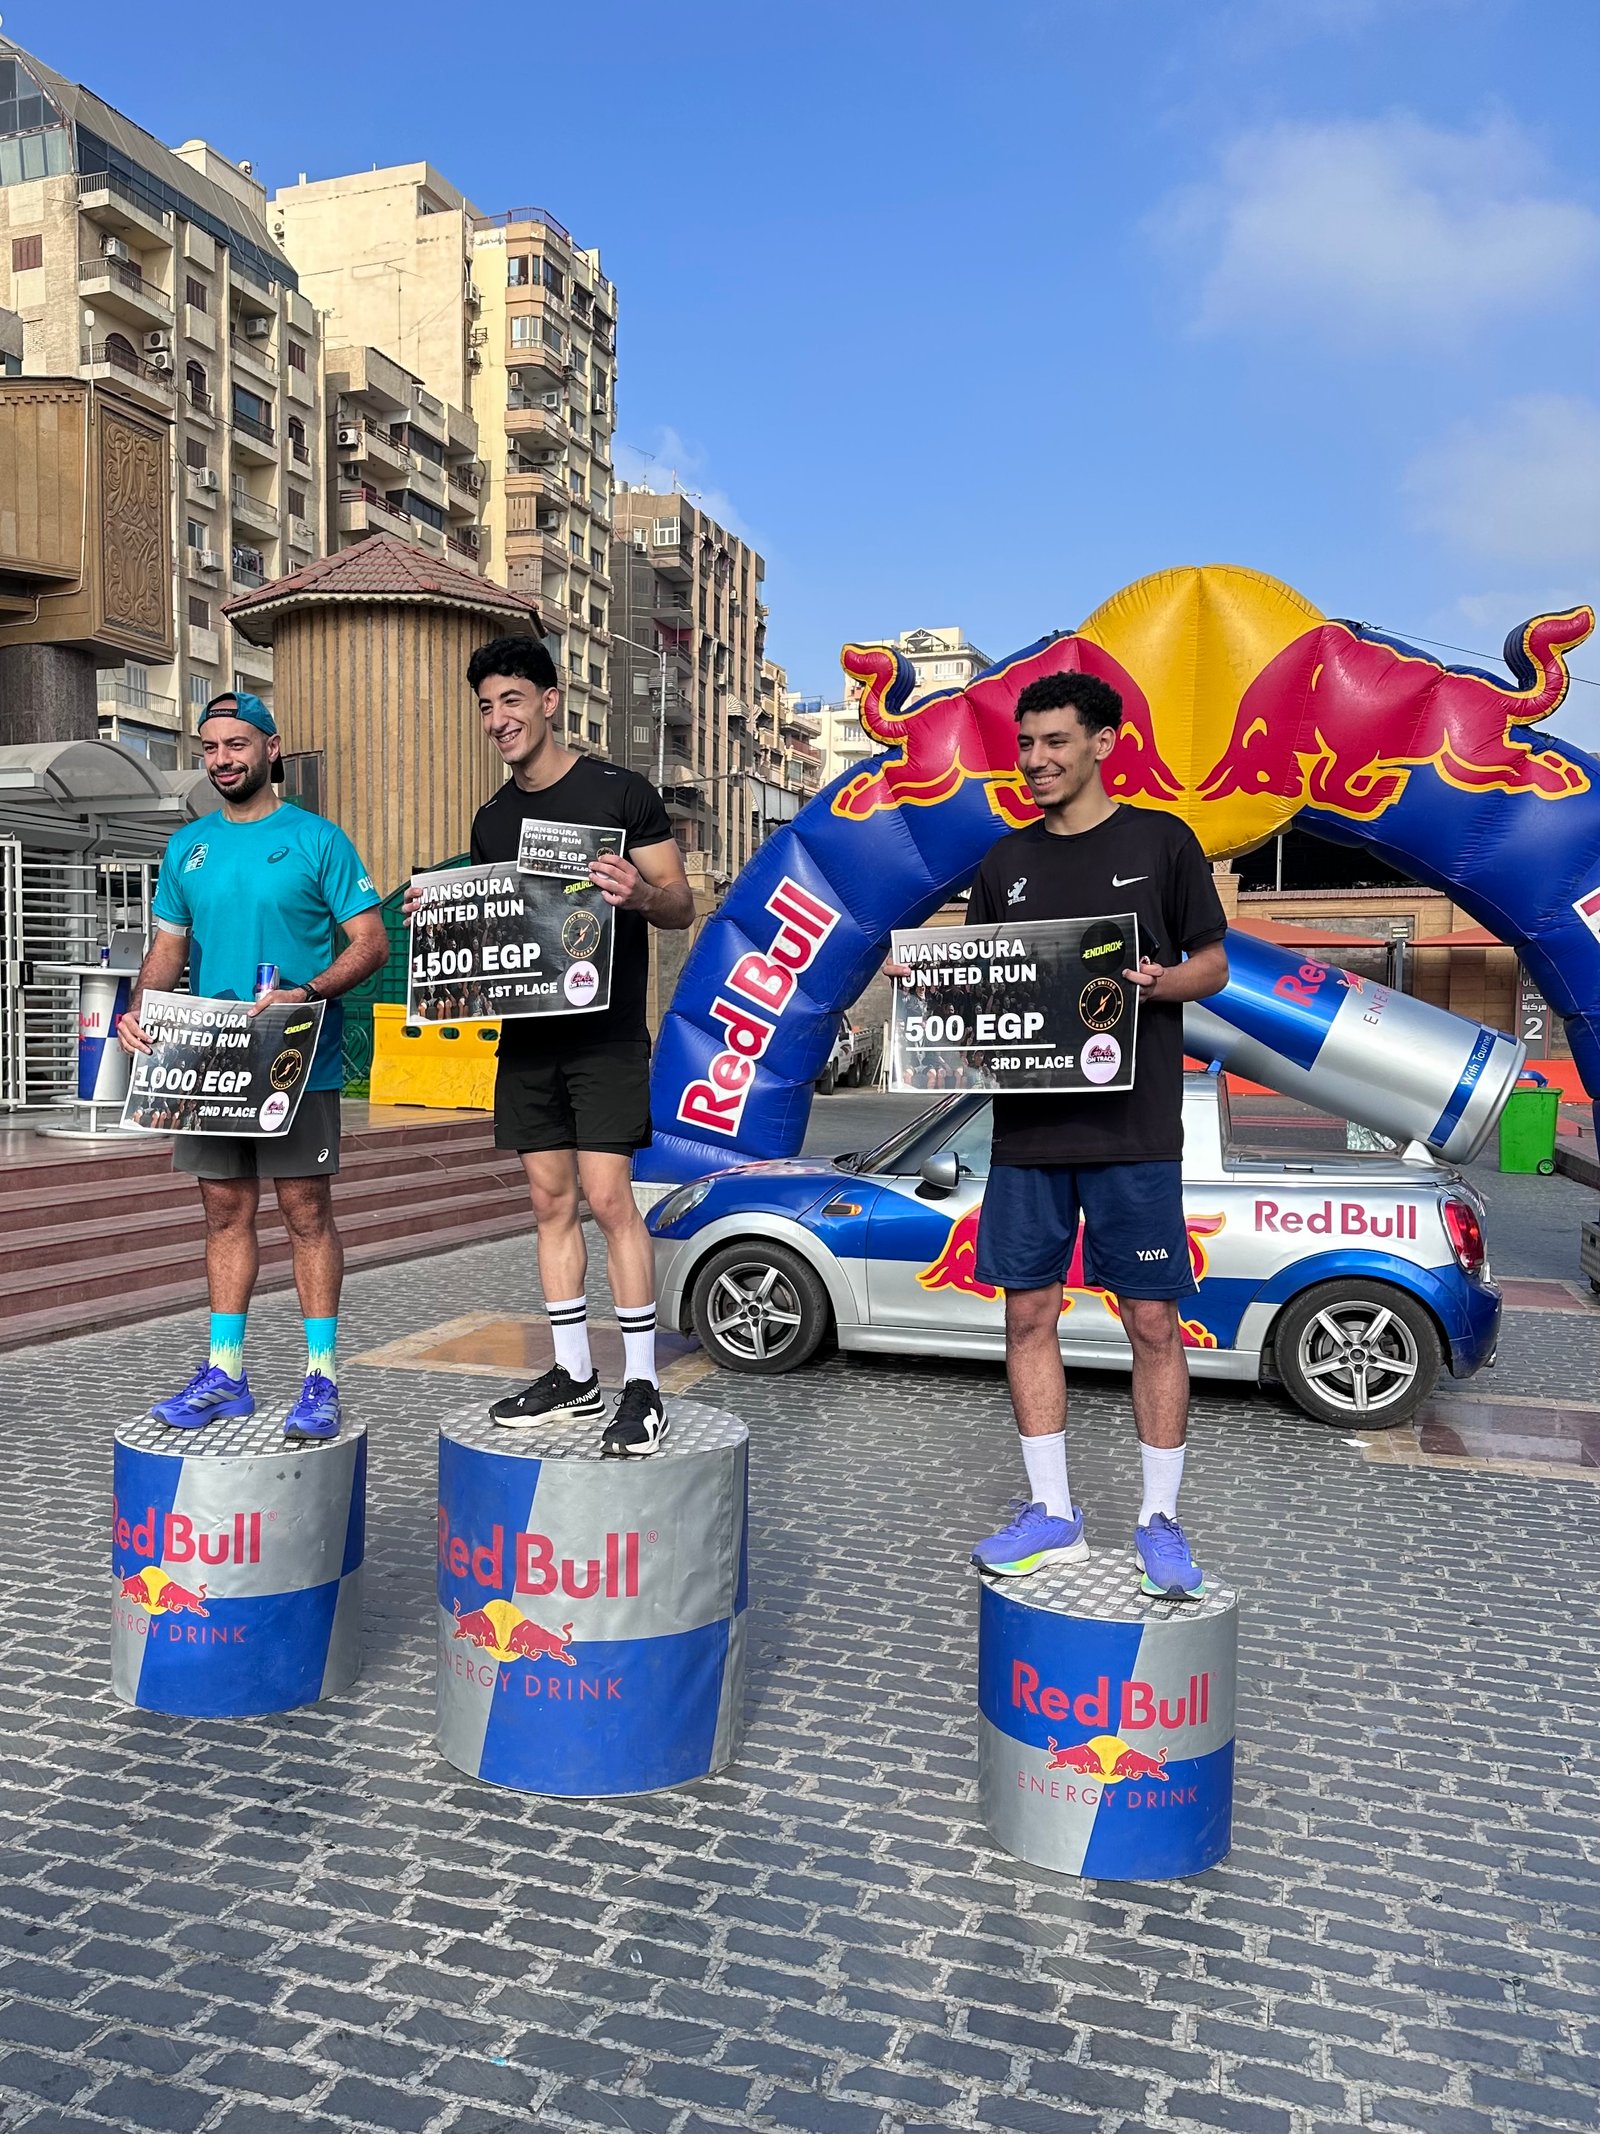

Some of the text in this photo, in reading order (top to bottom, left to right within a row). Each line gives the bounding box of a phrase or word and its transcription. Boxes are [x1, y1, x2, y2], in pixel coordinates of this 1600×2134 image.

[525, 825, 578, 837] MANSOURA
[525, 832, 582, 845] UNITED RUN
[521, 846, 587, 862] 1500 EGP
[572, 865, 592, 873] PLAC
[565, 880, 595, 895] ENDUR
[415, 899, 525, 928] UNITED RUN
[412, 942, 541, 979] 1500 EGP
[899, 938, 1026, 963] MANSOURA
[1083, 941, 1121, 960] ENDUROX
[901, 963, 1037, 988] UNITED RUN
[487, 982, 558, 999] 1ST PLACE
[1522, 992, 1544, 1001] حص
[147, 1003, 249, 1030] MANSOURA
[680, 881, 836, 1133] Red Bull
[1521, 1001, 1548, 1013] مركبة
[144, 1024, 252, 1049] UNITED RUN
[905, 1012, 1045, 1042] 500 EGP
[1523, 1016, 1544, 1040] 2
[990, 1055, 1075, 1071] 3RD PLACE
[1460, 1063, 1481, 1085] With
[134, 1065, 253, 1094] 1000 EGP
[198, 1105, 219, 1118] 2ND
[221, 1106, 258, 1118] PLACE
[1254, 1200, 1417, 1240] Red Bull
[1136, 1248, 1169, 1262] YAYA
[163, 1512, 262, 1565] Bull
[438, 1504, 640, 1599] Red Bull
[113, 1605, 248, 1645] NERGY DRINK
[525, 1674, 624, 1700] DRINK
[1011, 1658, 1210, 1730] Red Bull
[1017, 1768, 1199, 1809] ENERGY DRINK
